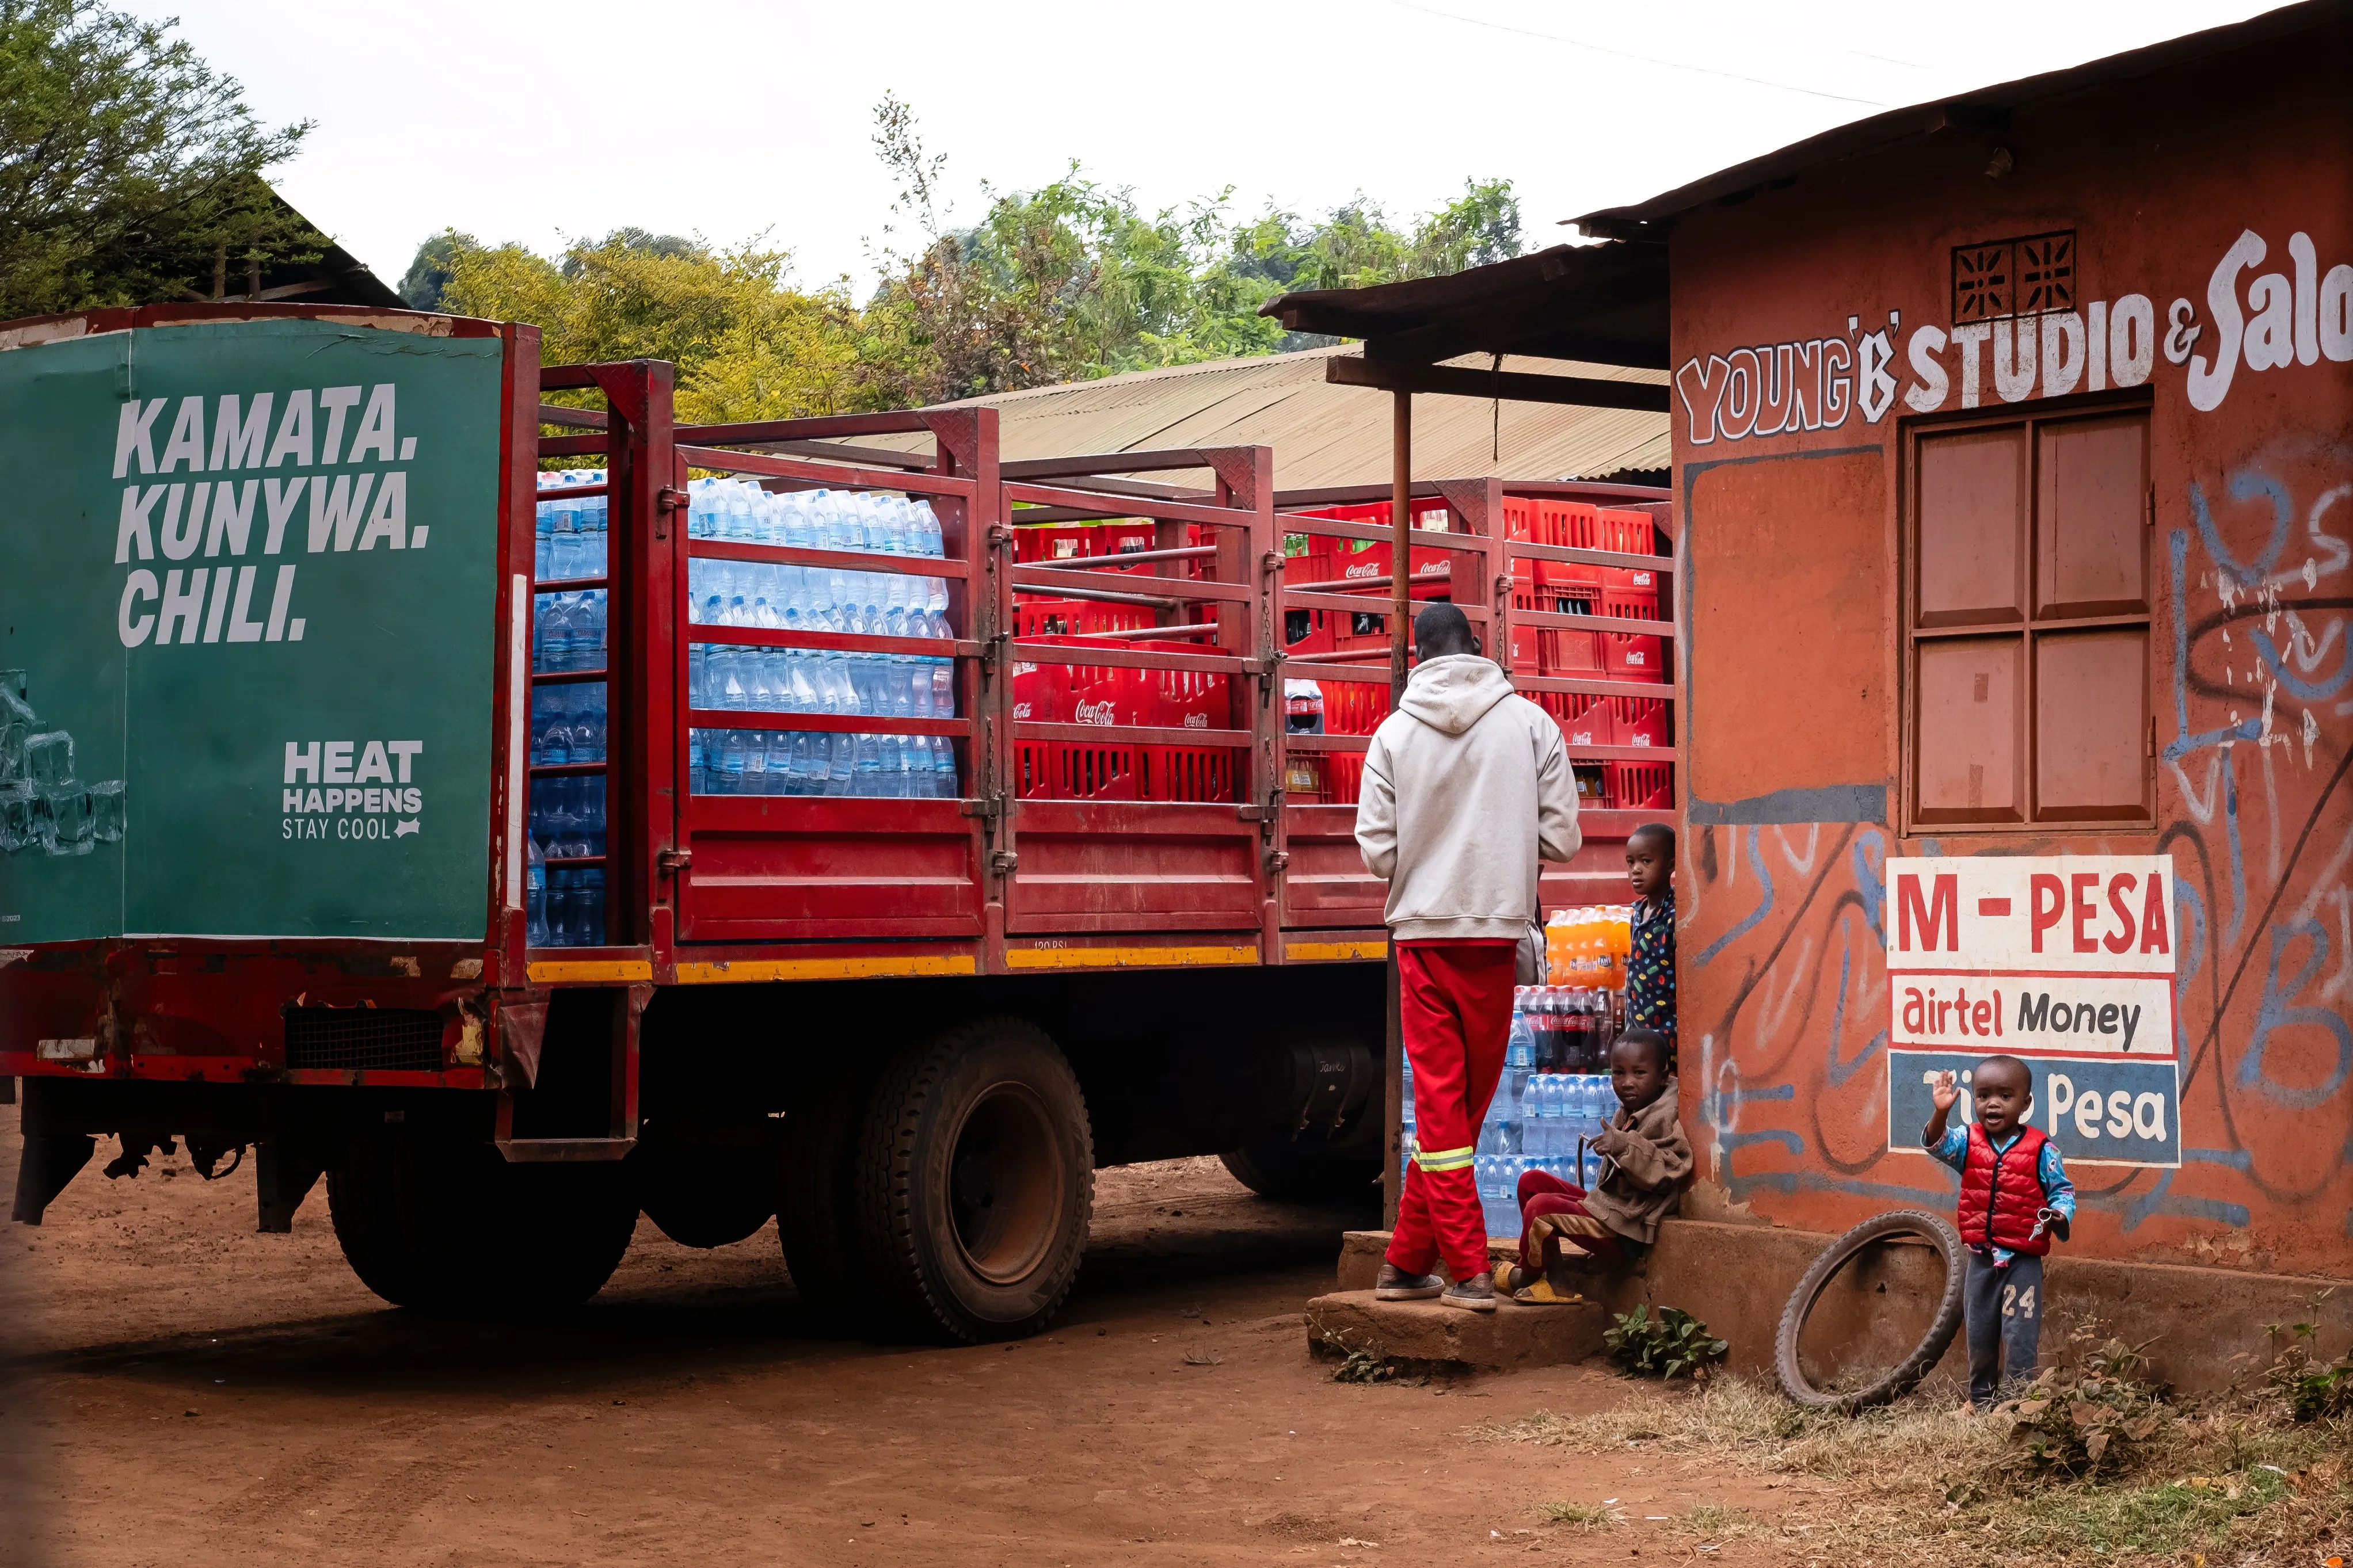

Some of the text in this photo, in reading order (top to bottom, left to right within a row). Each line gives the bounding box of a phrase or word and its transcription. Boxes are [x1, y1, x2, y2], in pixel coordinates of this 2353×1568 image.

[1676, 338, 1853, 445] YOUNG
[1903, 293, 2153, 411] STUDIO
[2164, 297, 2200, 365] &
[112, 383, 417, 478] KAMATA.
[115, 472, 429, 563] KUNYWA.
[1346, 563, 1380, 578] Coca-Cola
[119, 564, 306, 647] CHILL.
[1075, 699, 1115, 725] Coca-Cola
[1185, 713, 1208, 727] Coca-Cola
[284, 740, 423, 783] HEAT
[283, 788, 422, 814] HAPPENS
[282, 818, 391, 840] STAY COOL
[1898, 874, 1958, 952] M
[2031, 872, 2169, 954] PESA
[1902, 987, 2141, 1052] airtel Money
[2047, 1074, 2167, 1143] Pesa
[2002, 1284, 2035, 1318] 24
